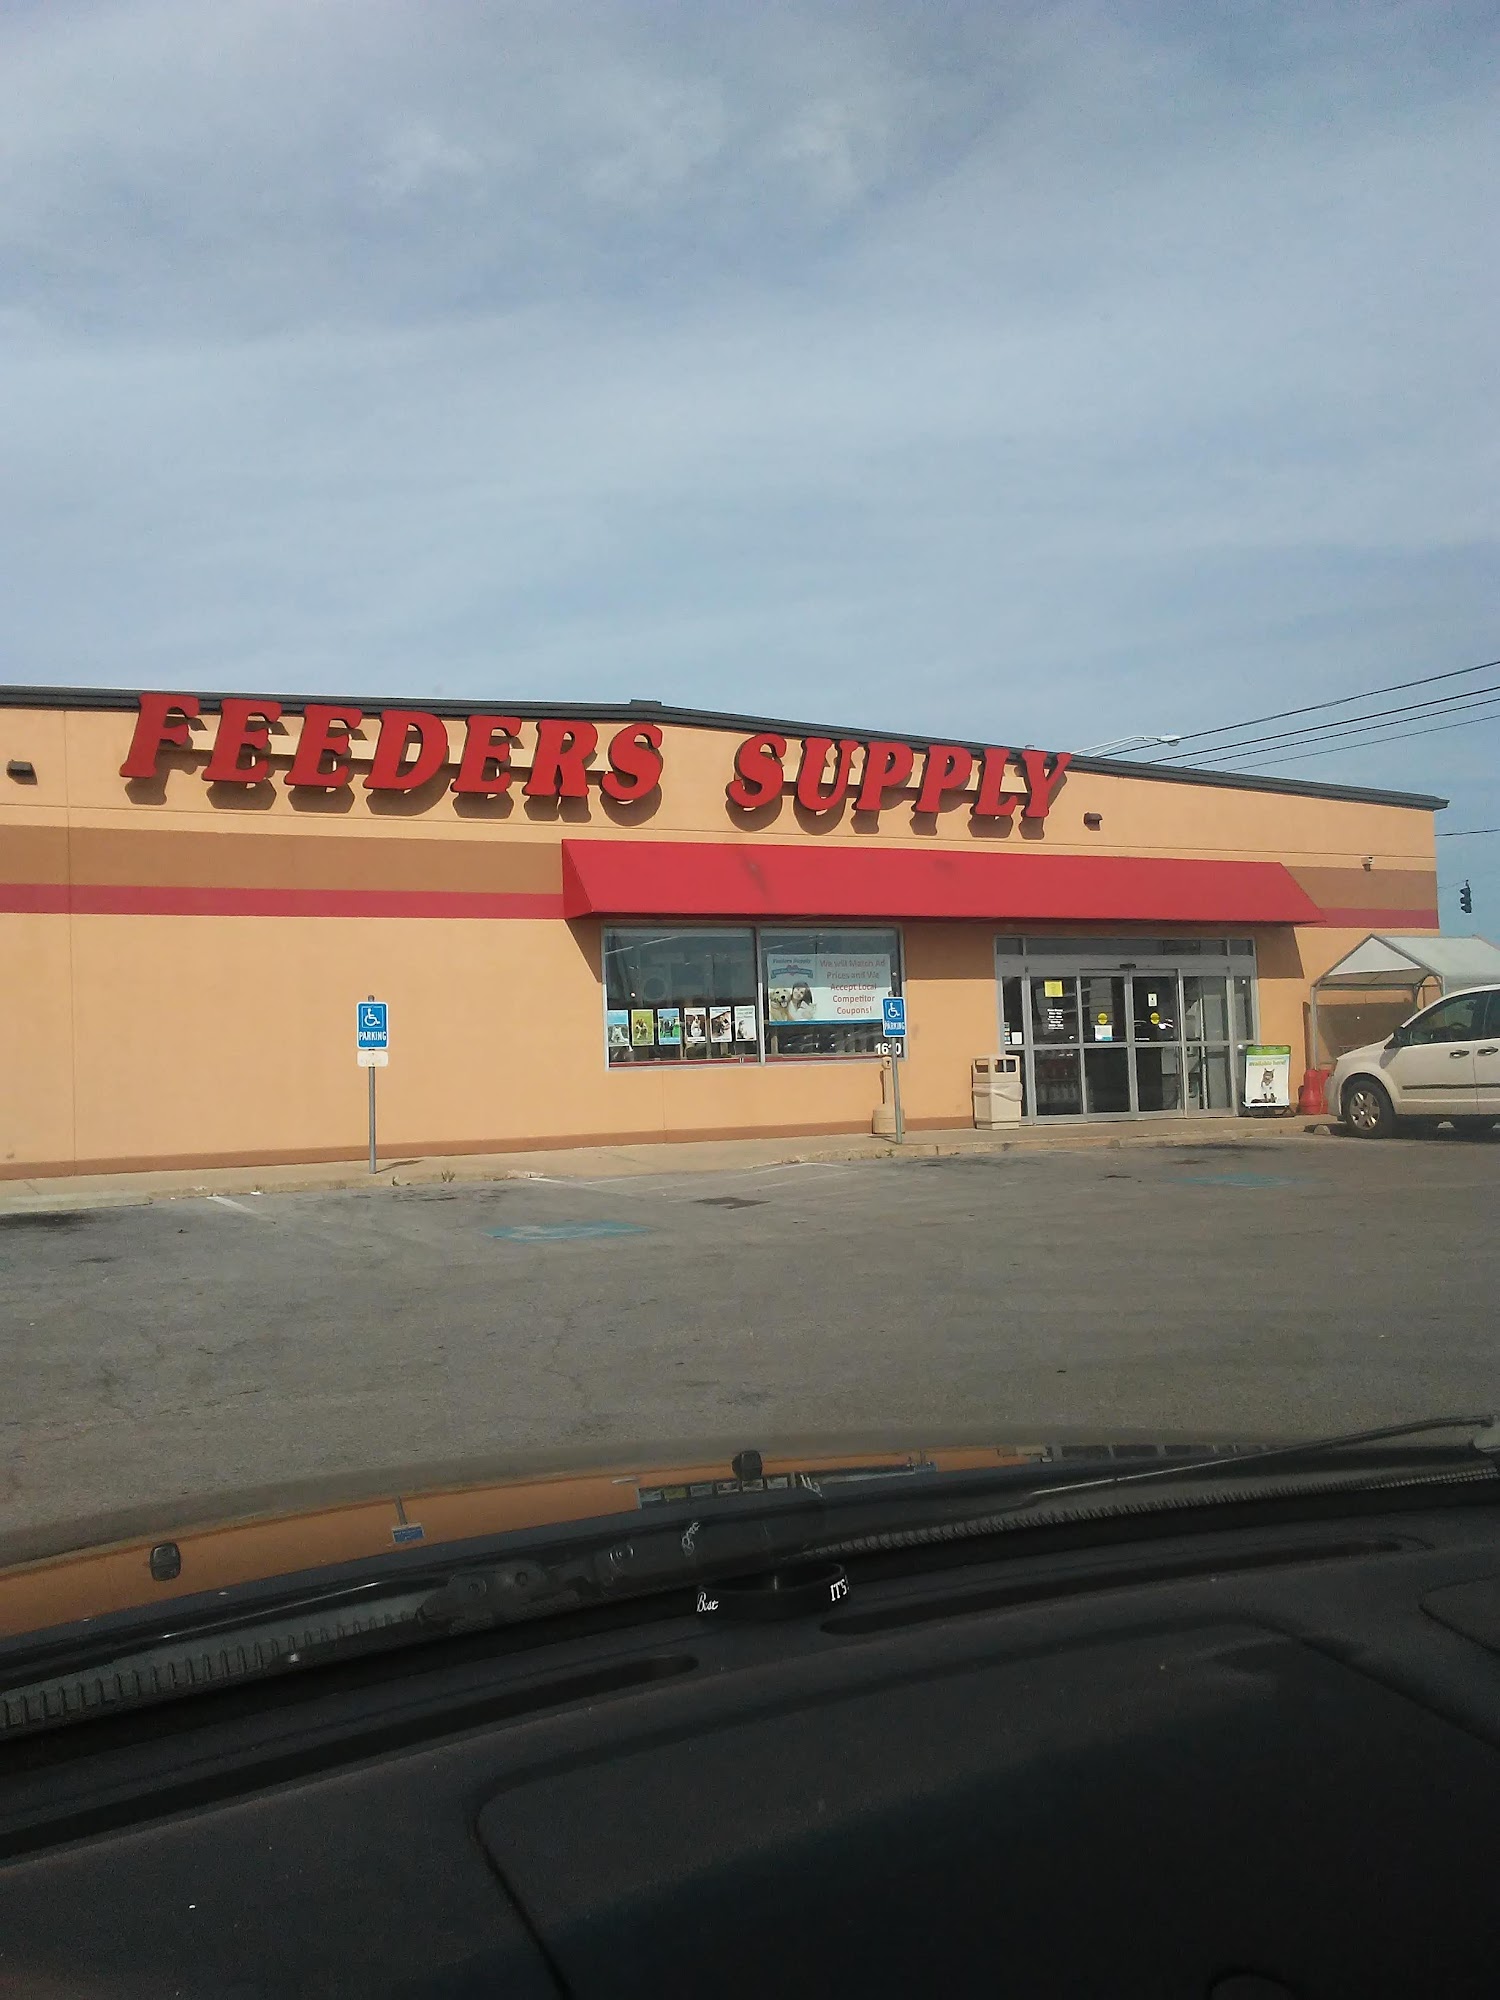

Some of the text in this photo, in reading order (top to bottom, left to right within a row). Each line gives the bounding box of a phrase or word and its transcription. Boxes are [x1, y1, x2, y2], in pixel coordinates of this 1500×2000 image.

[119, 692, 1072, 818] FEEDERS SUPPLY
[826, 971, 850, 980] Prices
[851, 971, 866, 979] and
[830, 983, 877, 992] Accept Local
[832, 994, 876, 1004] Competitor
[836, 1006, 873, 1016] Coupons!
[884, 1021, 905, 1031] PARKING
[359, 1031, 388, 1041] PARKING
